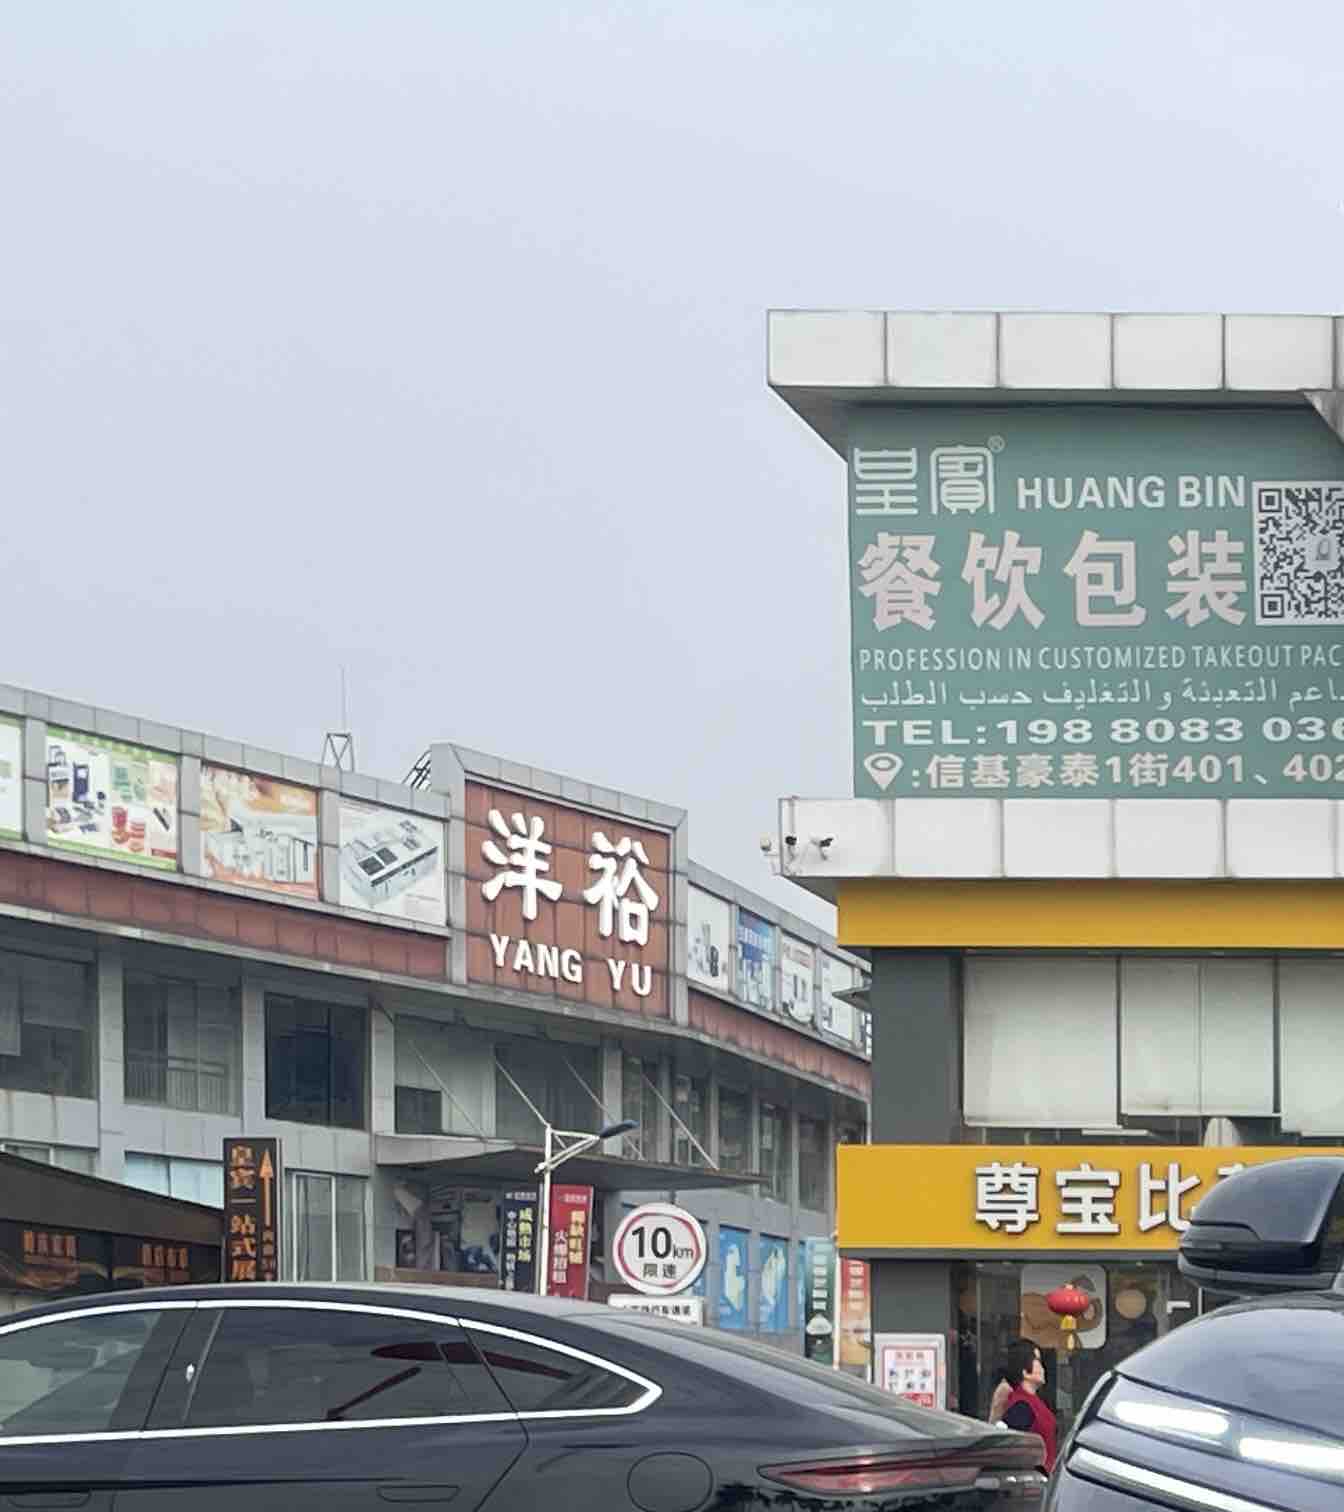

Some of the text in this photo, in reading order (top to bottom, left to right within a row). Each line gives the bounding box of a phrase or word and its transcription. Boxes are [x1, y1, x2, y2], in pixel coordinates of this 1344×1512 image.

[1016, 475, 1247, 510] HUANG BIN
[857, 529, 1248, 632] 餐饮包装
[859, 647, 1001, 671] PROFESSION
[1008, 646, 1031, 669] IN
[1038, 645, 1186, 670] CUSTOMIZED
[1191, 644, 1295, 668] TAKEOUT
[1110, 717, 1244, 743] 8083
[481, 808, 660, 947] 洋裕
[489, 932, 653, 997] YANG YU
